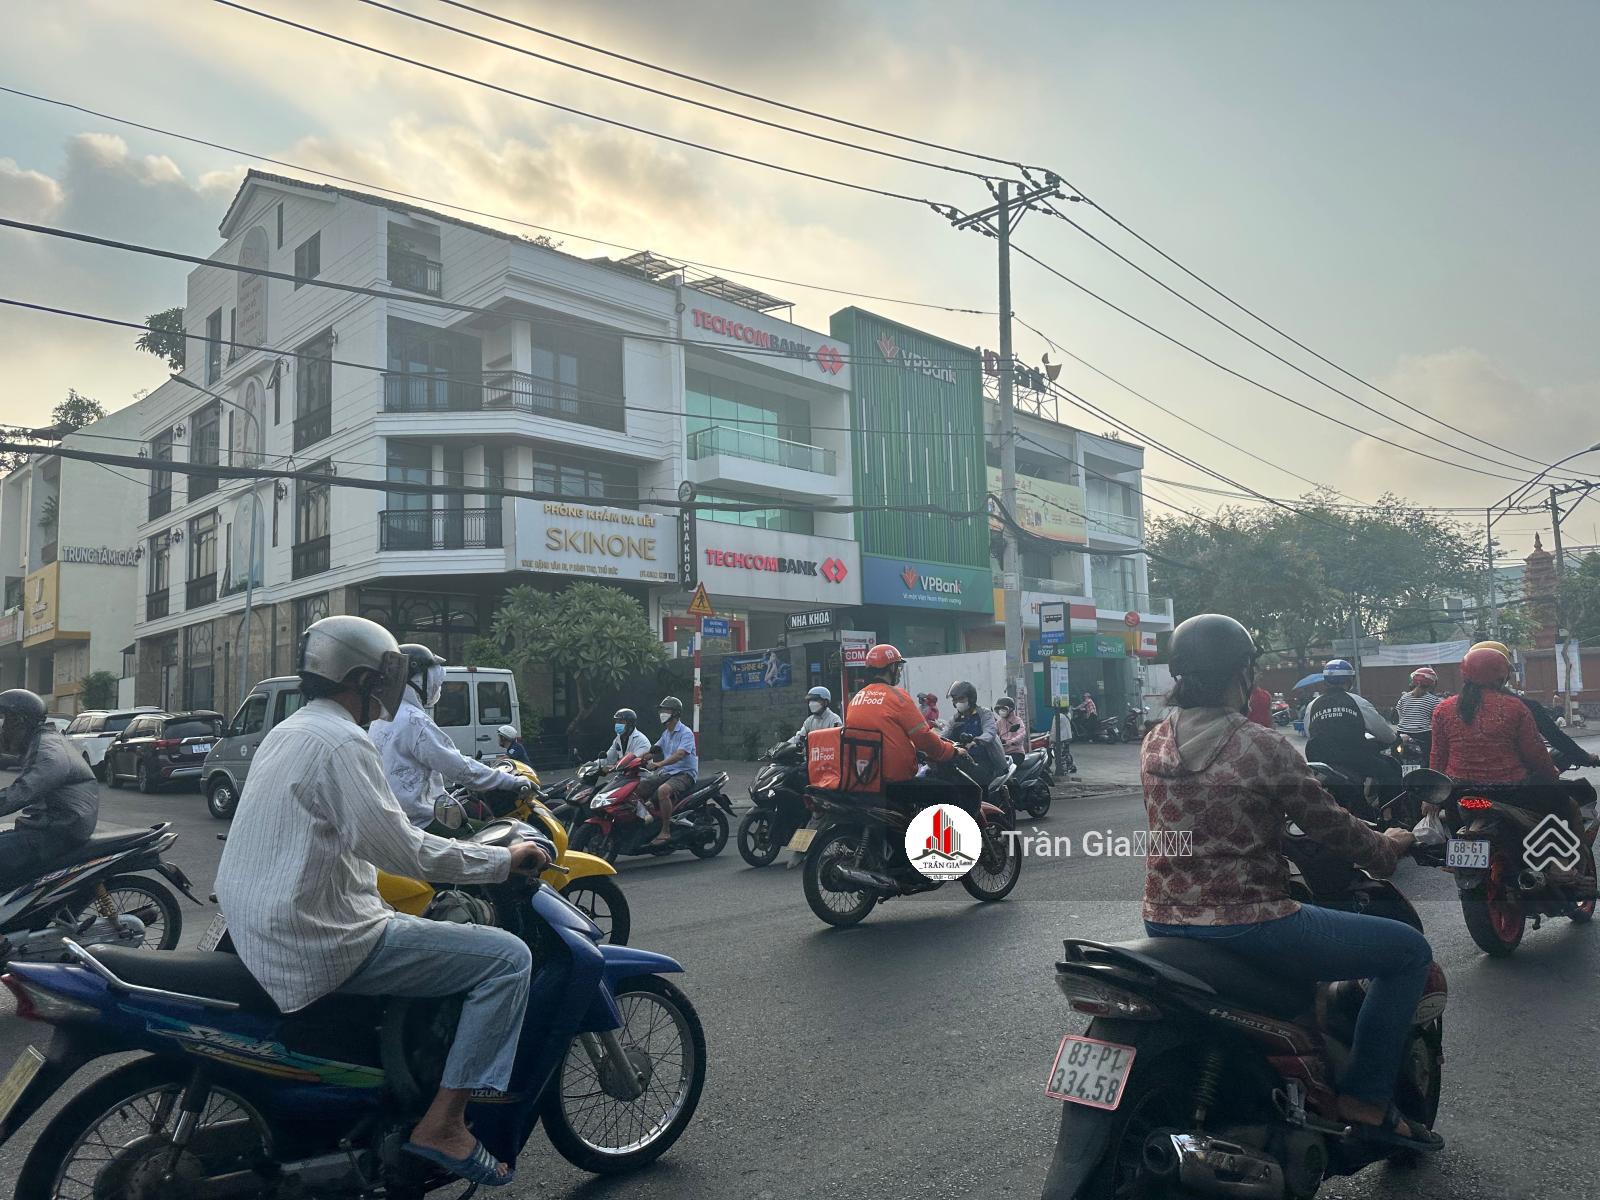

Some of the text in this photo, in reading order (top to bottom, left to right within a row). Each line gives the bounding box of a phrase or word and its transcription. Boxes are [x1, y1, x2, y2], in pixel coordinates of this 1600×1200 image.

[691, 308, 812, 362] TECHCOMBANK
[902, 349, 956, 385] VPBank
[545, 527, 657, 561] SKINONE
[63, 546, 95, 562] TRUNG
[705, 548, 818, 577] TECHCOMBANK
[920, 575, 962, 594] VPBank
[791, 611, 830, 628] NHA KHOA
[1037, 648, 1065, 656] exprss
[862, 697, 884, 705] Food
[1320, 712, 1343, 720] STUDIO
[1453, 842, 1483, 853] 68-G1
[1449, 854, 1487, 866] 987.73
[1051, 1068, 1120, 1104] 334.58
